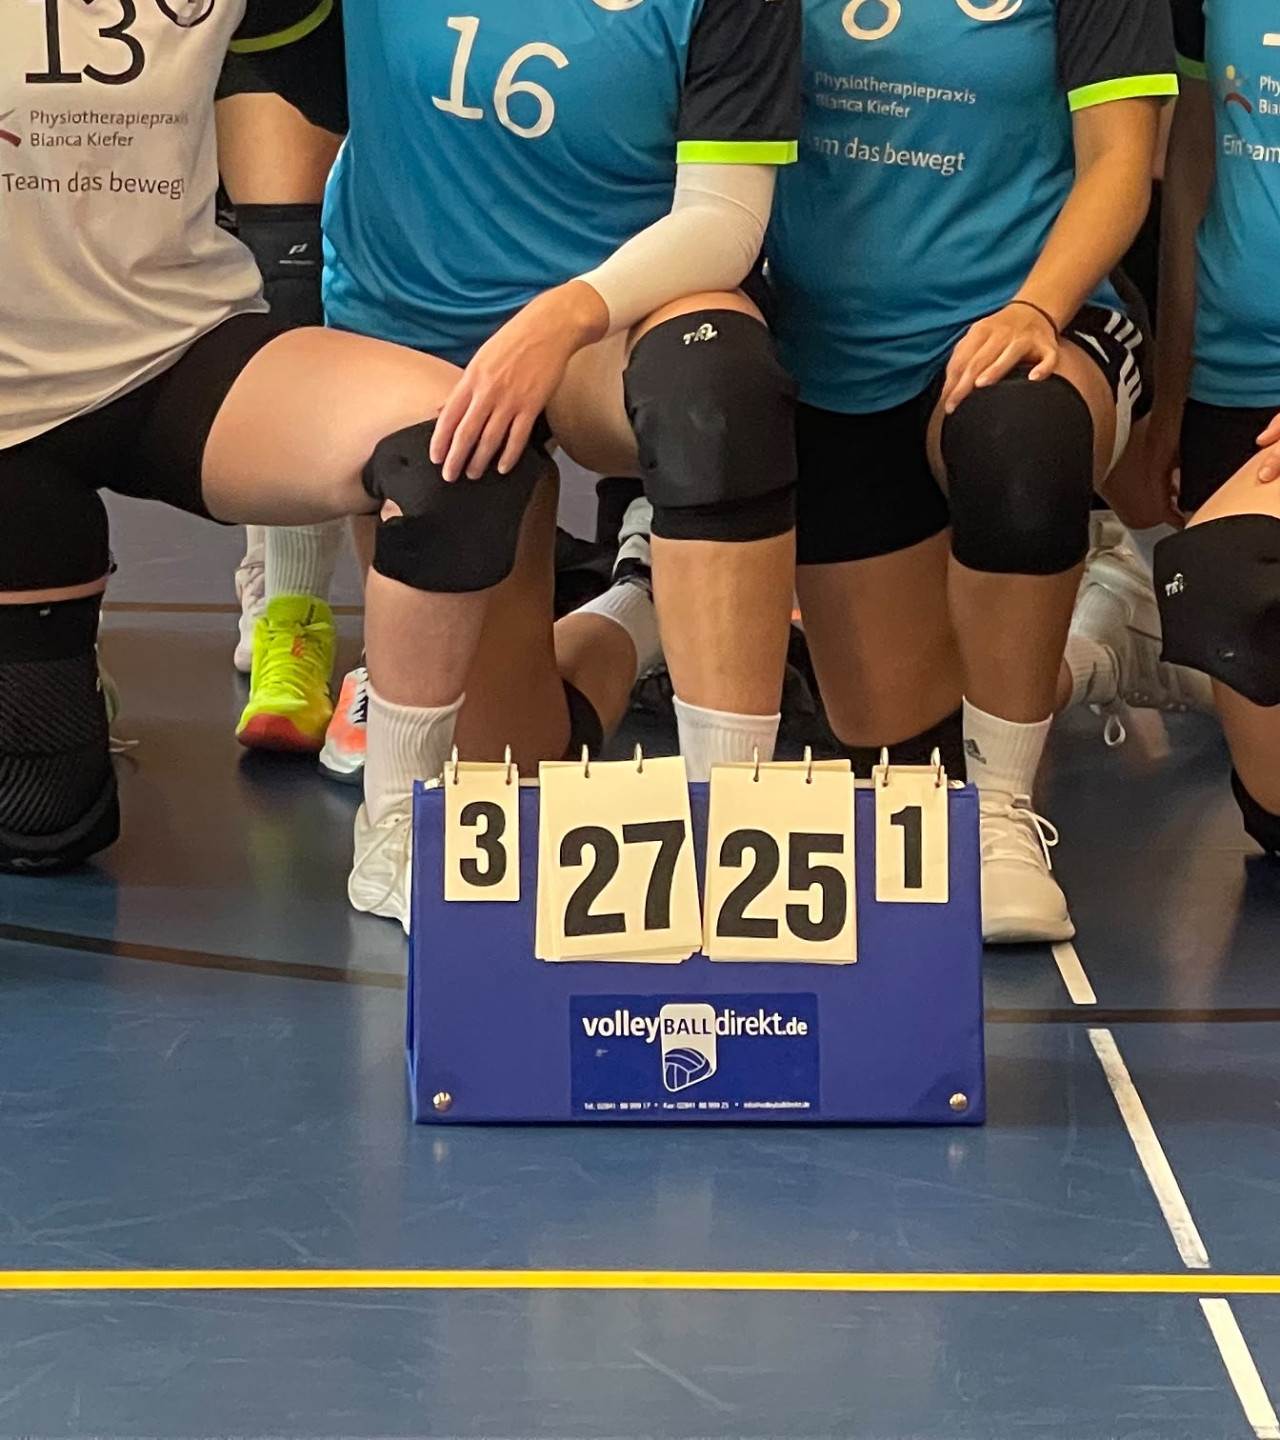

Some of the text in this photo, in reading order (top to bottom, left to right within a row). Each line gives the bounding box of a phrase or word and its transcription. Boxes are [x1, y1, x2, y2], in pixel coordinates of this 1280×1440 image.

[431, 15, 570, 139] 16
[867, 98, 911, 119] Kiefer
[30, 131, 134, 147] Bianca Kiefer
[844, 137, 880, 162] das
[884, 142, 966, 176] bewegt
[2, 172, 60, 194] Team
[67, 171, 102, 193] das
[459, 801, 923, 942] 3 27 25 1
